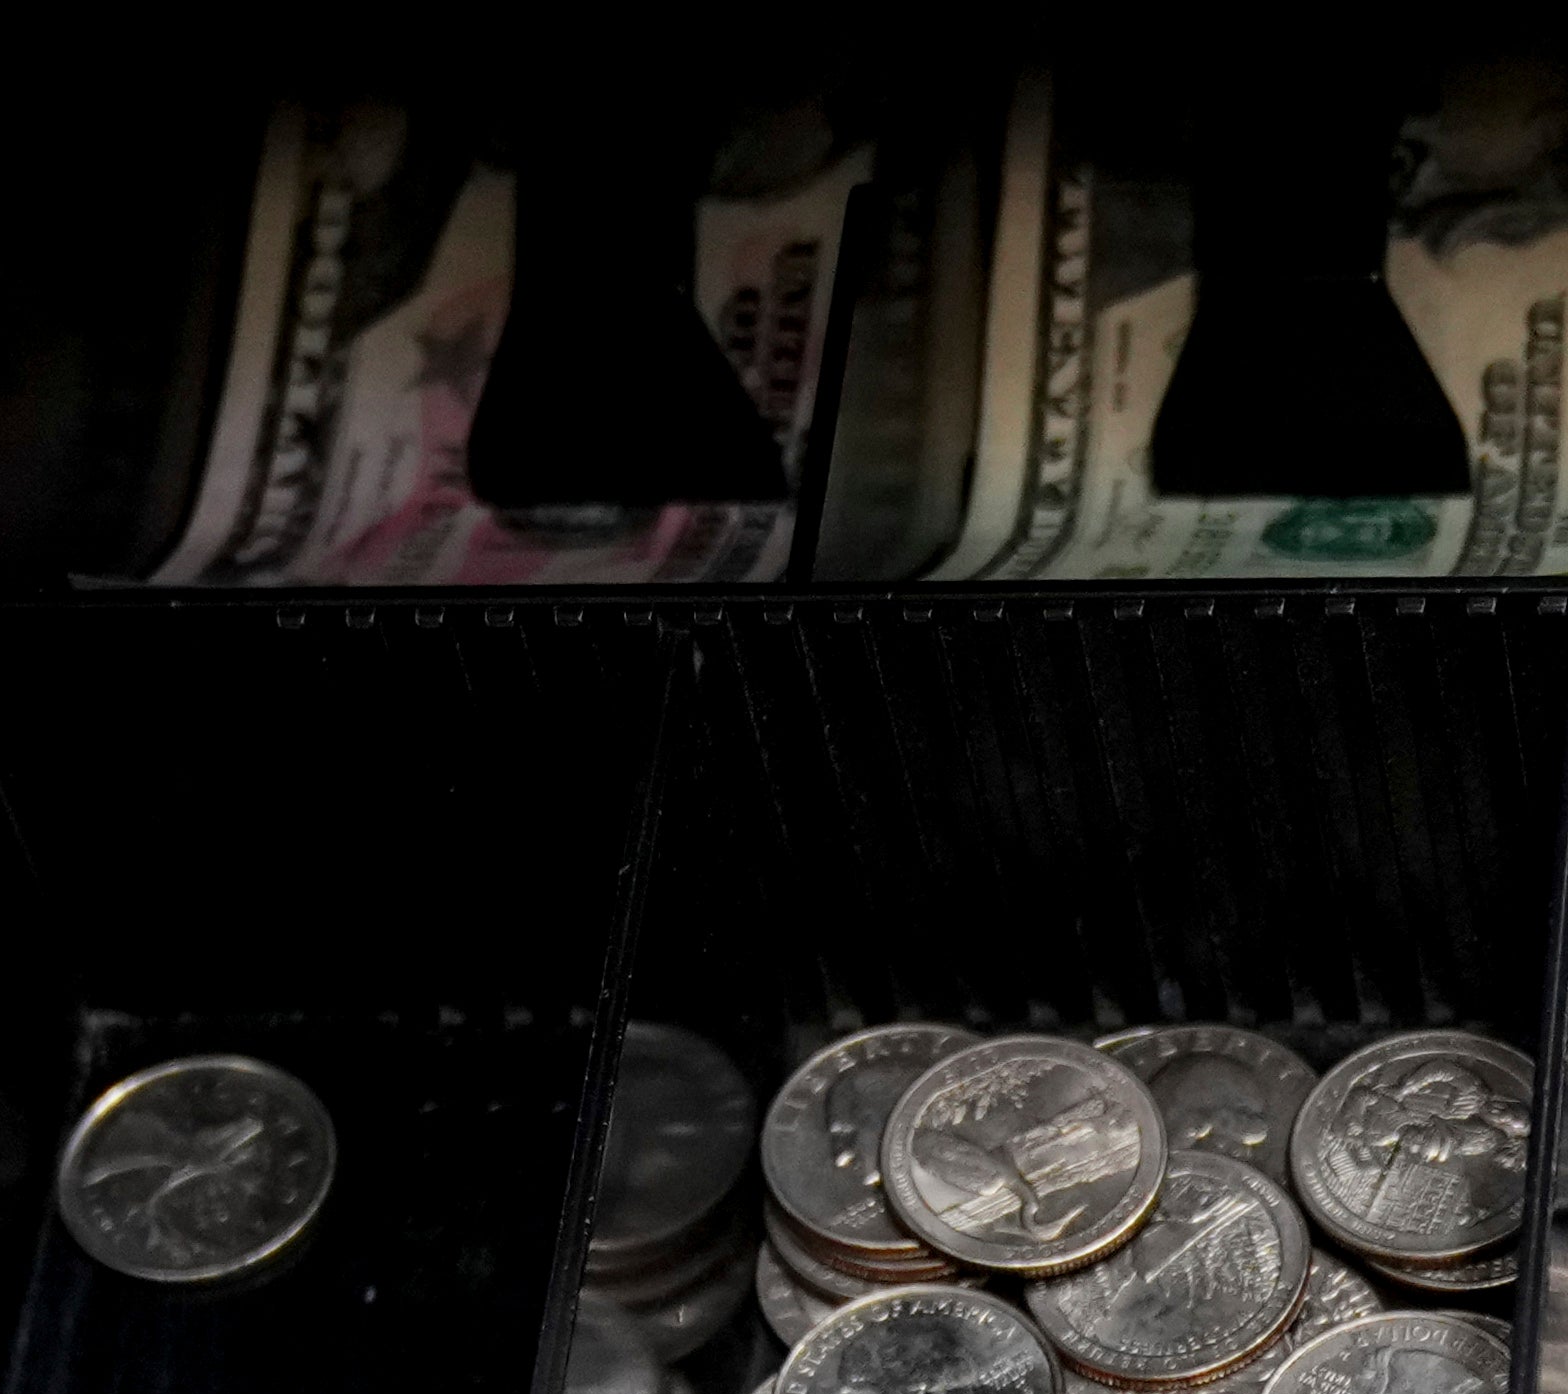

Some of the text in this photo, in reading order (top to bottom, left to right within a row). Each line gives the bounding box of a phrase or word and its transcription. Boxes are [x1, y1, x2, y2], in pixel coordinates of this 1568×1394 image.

[1038, 178, 1087, 501] TWENTY
[1480, 361, 1520, 454] OF
[1518, 293, 1567, 532] UNITED
[795, 1316, 866, 1379] STATES
[870, 1299, 903, 1323] OF
[905, 1297, 1018, 1342] AMERICA
